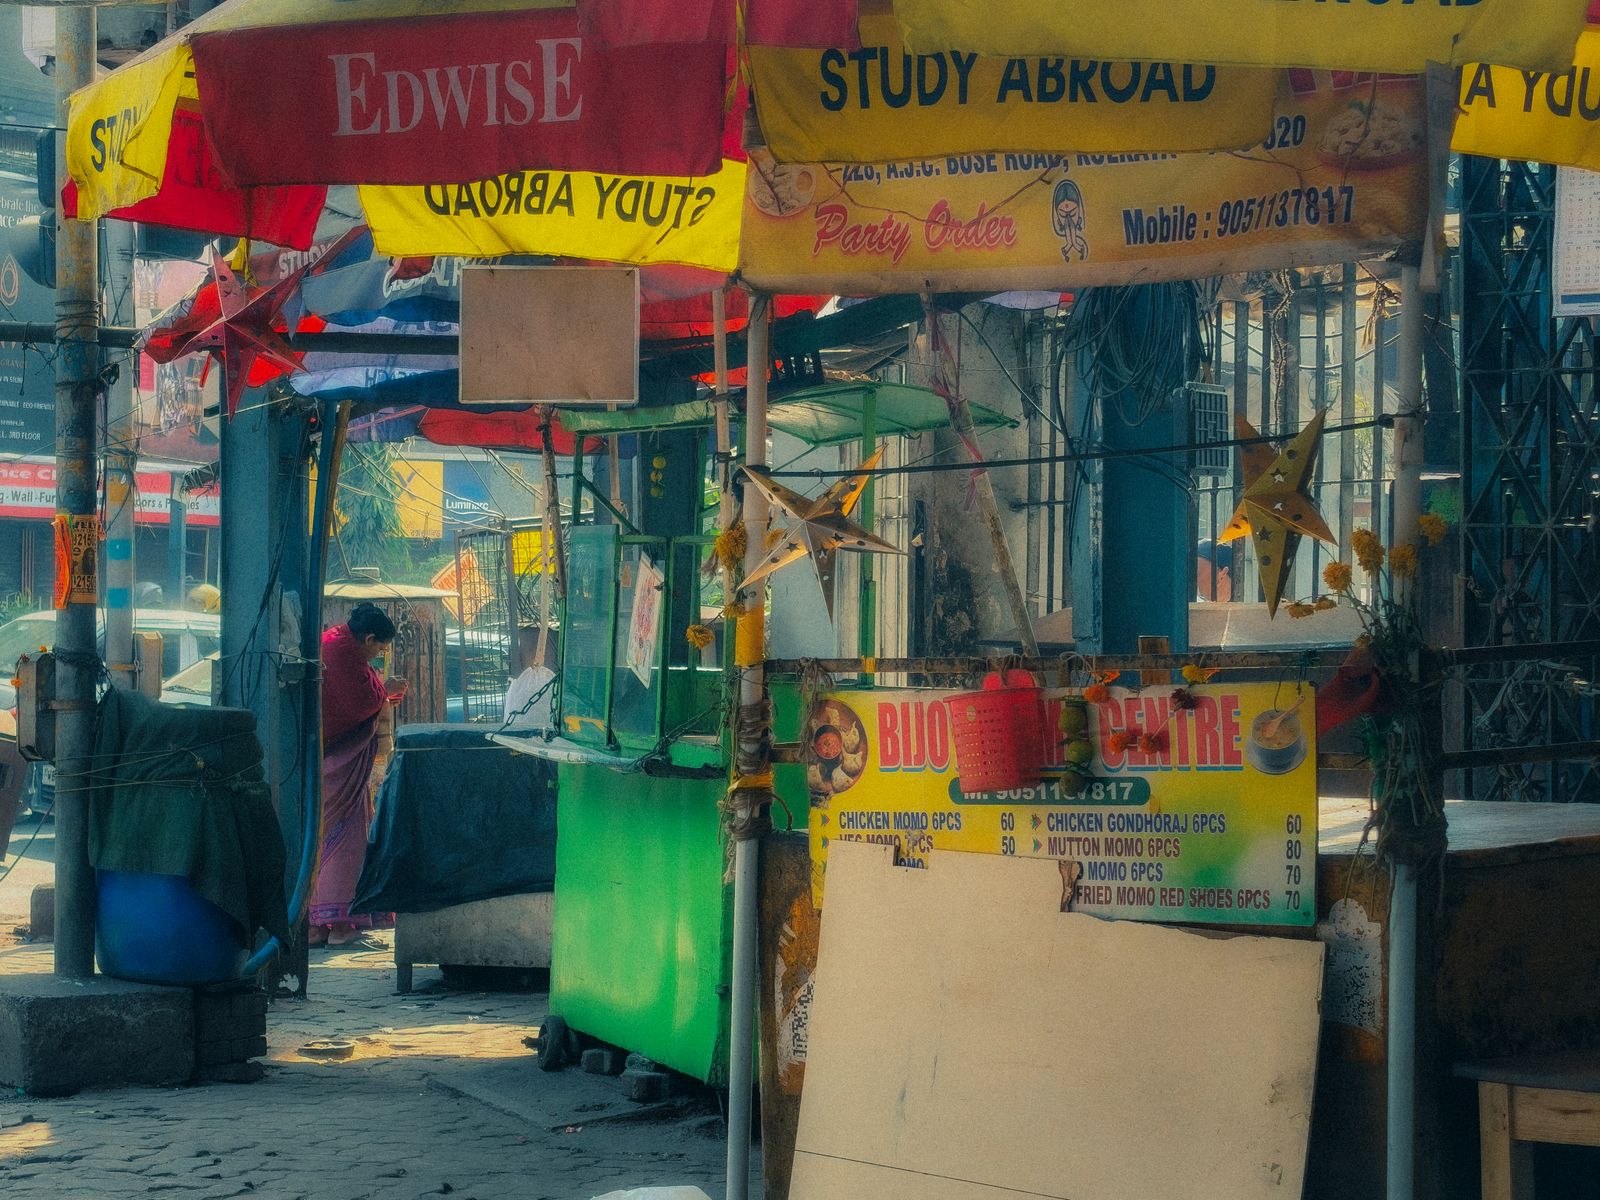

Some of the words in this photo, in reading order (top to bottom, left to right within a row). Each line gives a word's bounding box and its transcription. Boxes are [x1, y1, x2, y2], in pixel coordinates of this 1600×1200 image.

[329, 37, 584, 138] EDWISE
[821, 46, 978, 110] STUDY
[997, 57, 1215, 103] ABROAD
[813, 202, 912, 264] Party
[923, 200, 1017, 250] Order
[1122, 205, 1197, 246] Mobile
[1217, 185, 1354, 238] 9051137817
[21, 432, 40, 441] FLOOR
[11, 490, 33, 502] Wall
[1098, 694, 1243, 769] CENTRE
[839, 811, 890, 830] CHICKEN
[893, 812, 928, 831] MOMO
[932, 812, 962, 831] 6PCS
[1001, 813, 1015, 831] 60
[1047, 812, 1104, 833] CHICKEN
[1107, 812, 1188, 834] GONDHORAJ
[1192, 813, 1226, 834] 6PCS
[1286, 814, 1302, 834] 60
[1002, 836, 1016, 855] 50
[1047, 836, 1101, 857] MUTTON
[1104, 837, 1144, 857] MOMO
[1148, 837, 1181, 858] 6PCS
[1286, 839, 1302, 860] 80
[1088, 861, 1127, 881] MOMO
[1131, 862, 1163, 882] 6PCS
[1285, 865, 1301, 885] 70
[1076, 885, 1113, 905] FRIED
[1116, 886, 1155, 906] MOMO
[1160, 887, 1185, 908] RED
[1189, 888, 1233, 909] SHOES
[1237, 889, 1271, 910] 6PCS
[1285, 891, 1301, 910] 70
